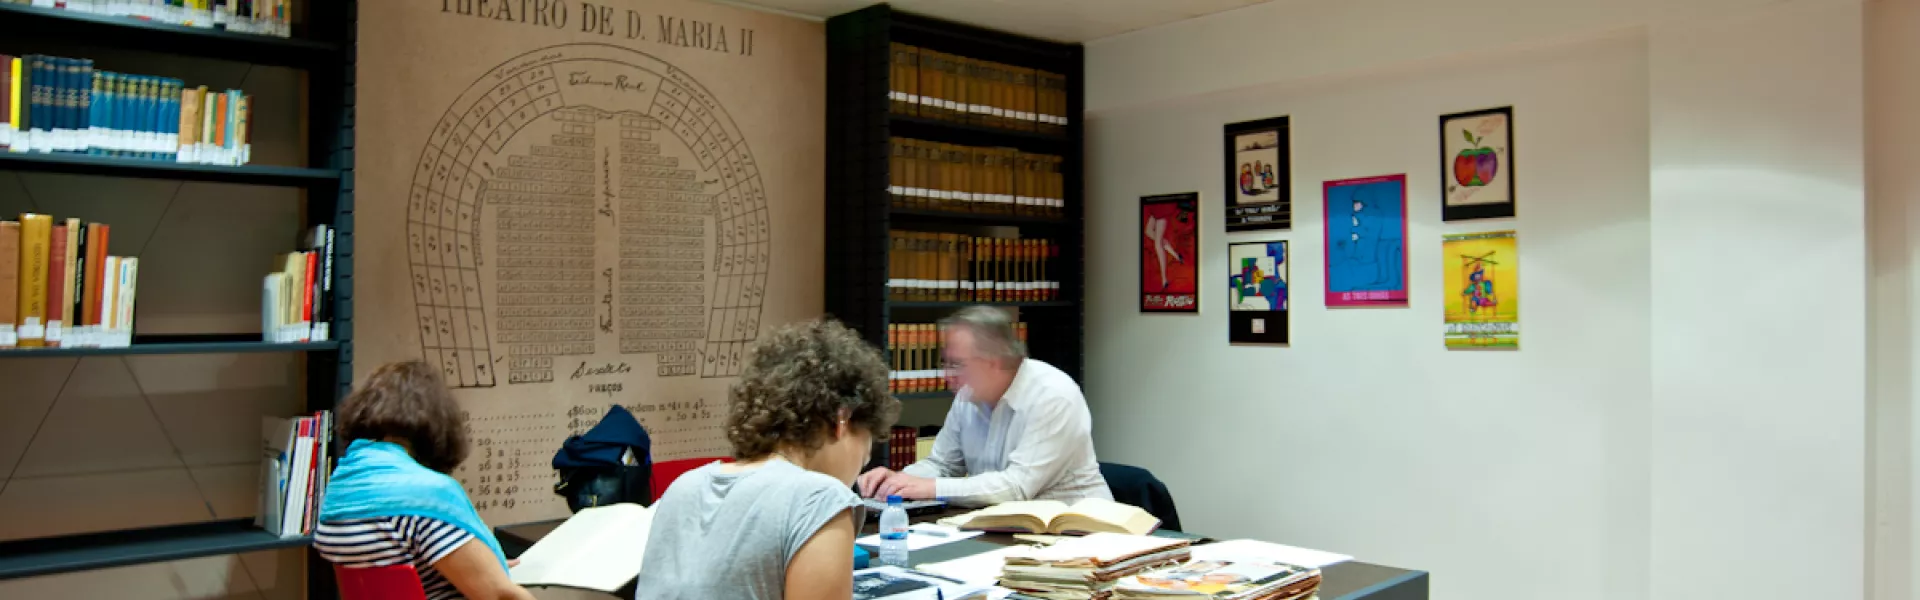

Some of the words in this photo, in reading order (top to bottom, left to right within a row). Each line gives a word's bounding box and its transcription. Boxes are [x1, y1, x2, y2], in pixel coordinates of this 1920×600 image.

[580, 2, 613, 36] DE
[627, 9, 645, 41] D.
[656, 14, 729, 53] MARIA
[739, 28, 754, 56] II
